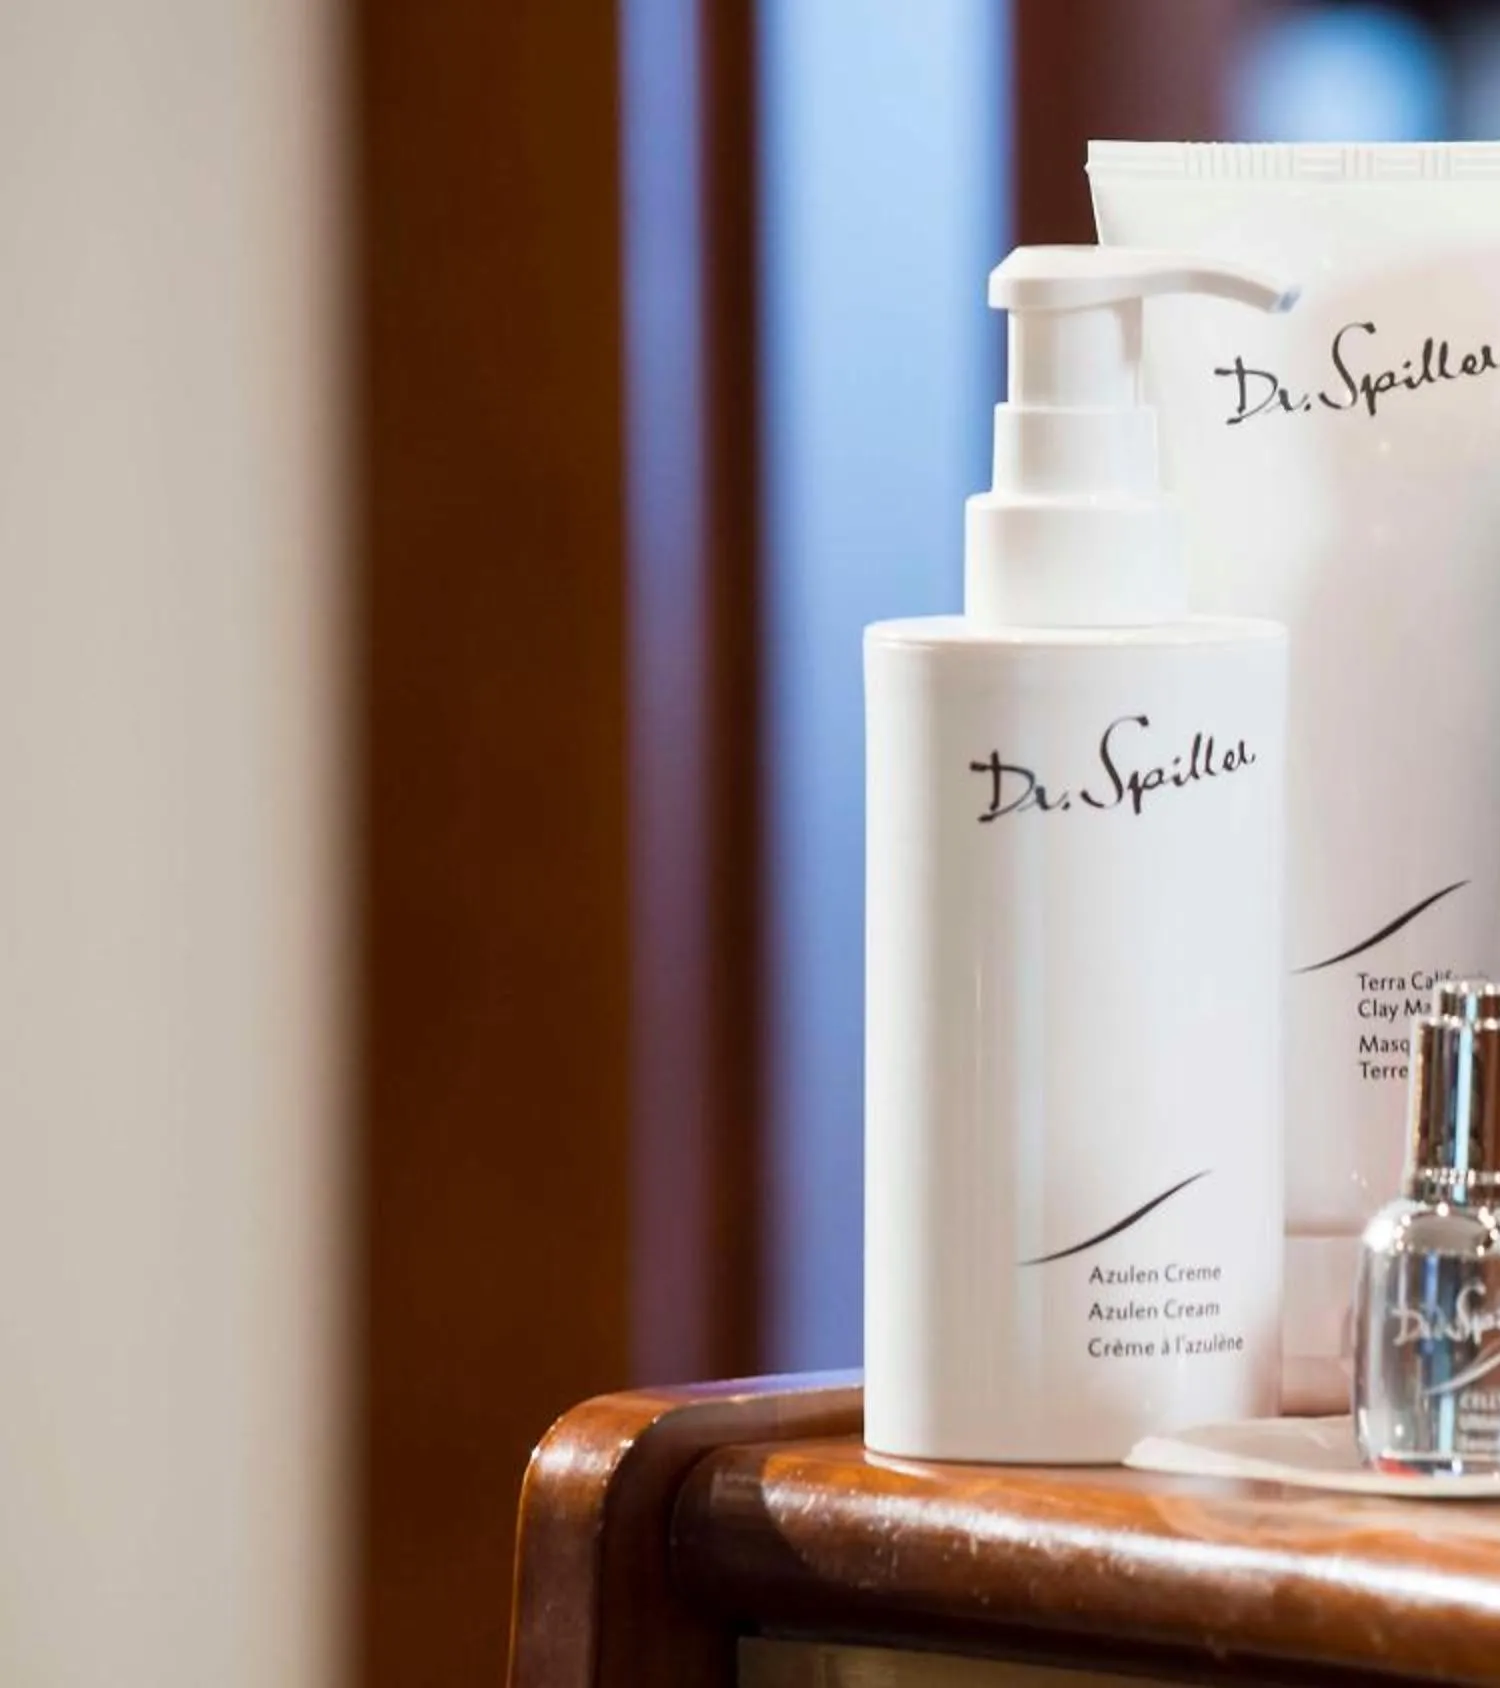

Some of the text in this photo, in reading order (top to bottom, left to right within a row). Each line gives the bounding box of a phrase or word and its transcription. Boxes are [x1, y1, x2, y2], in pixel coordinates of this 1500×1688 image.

[1213, 355, 1312, 425] Dr.
[969, 714, 1257, 824] Dr. Spiller
[1357, 971, 1405, 991] Terra
[1357, 997, 1432, 1023] Clay Ma
[1359, 1034, 1411, 1057] Masq
[1359, 1060, 1409, 1080] Terre
[1088, 1262, 1222, 1285] Azulen Creme
[1088, 1299, 1220, 1321] Azulen Cream
[1087, 1337, 1155, 1358] Crème
[1161, 1339, 1170, 1356] à
